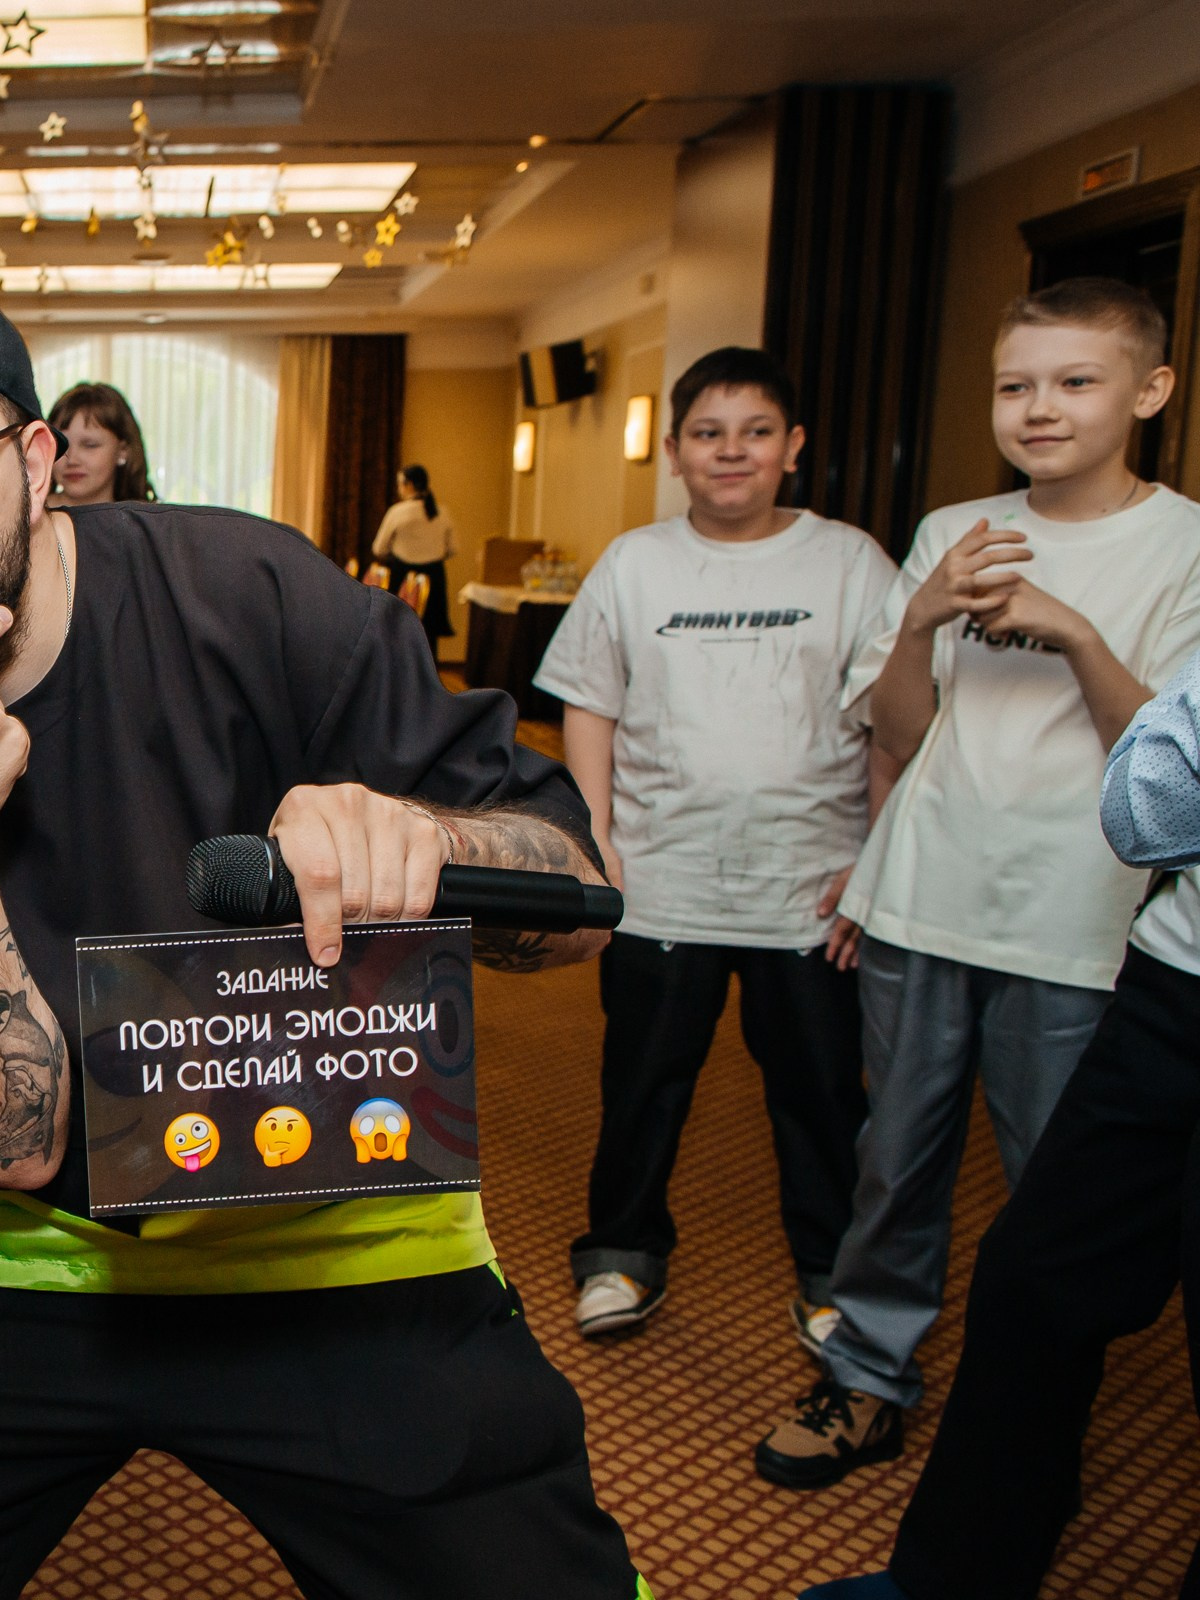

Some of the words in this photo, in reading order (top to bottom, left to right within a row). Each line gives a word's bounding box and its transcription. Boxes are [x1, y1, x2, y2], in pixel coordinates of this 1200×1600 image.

[216, 966, 329, 996] ЗАДАНИЕ
[119, 1013, 272, 1051] ПОВТОРИ
[285, 1002, 436, 1041] ЭМОДЖИ
[142, 1064, 163, 1093] И
[176, 1048, 302, 1092] СДЕЛАЙ
[315, 1046, 418, 1081] ФОТО
